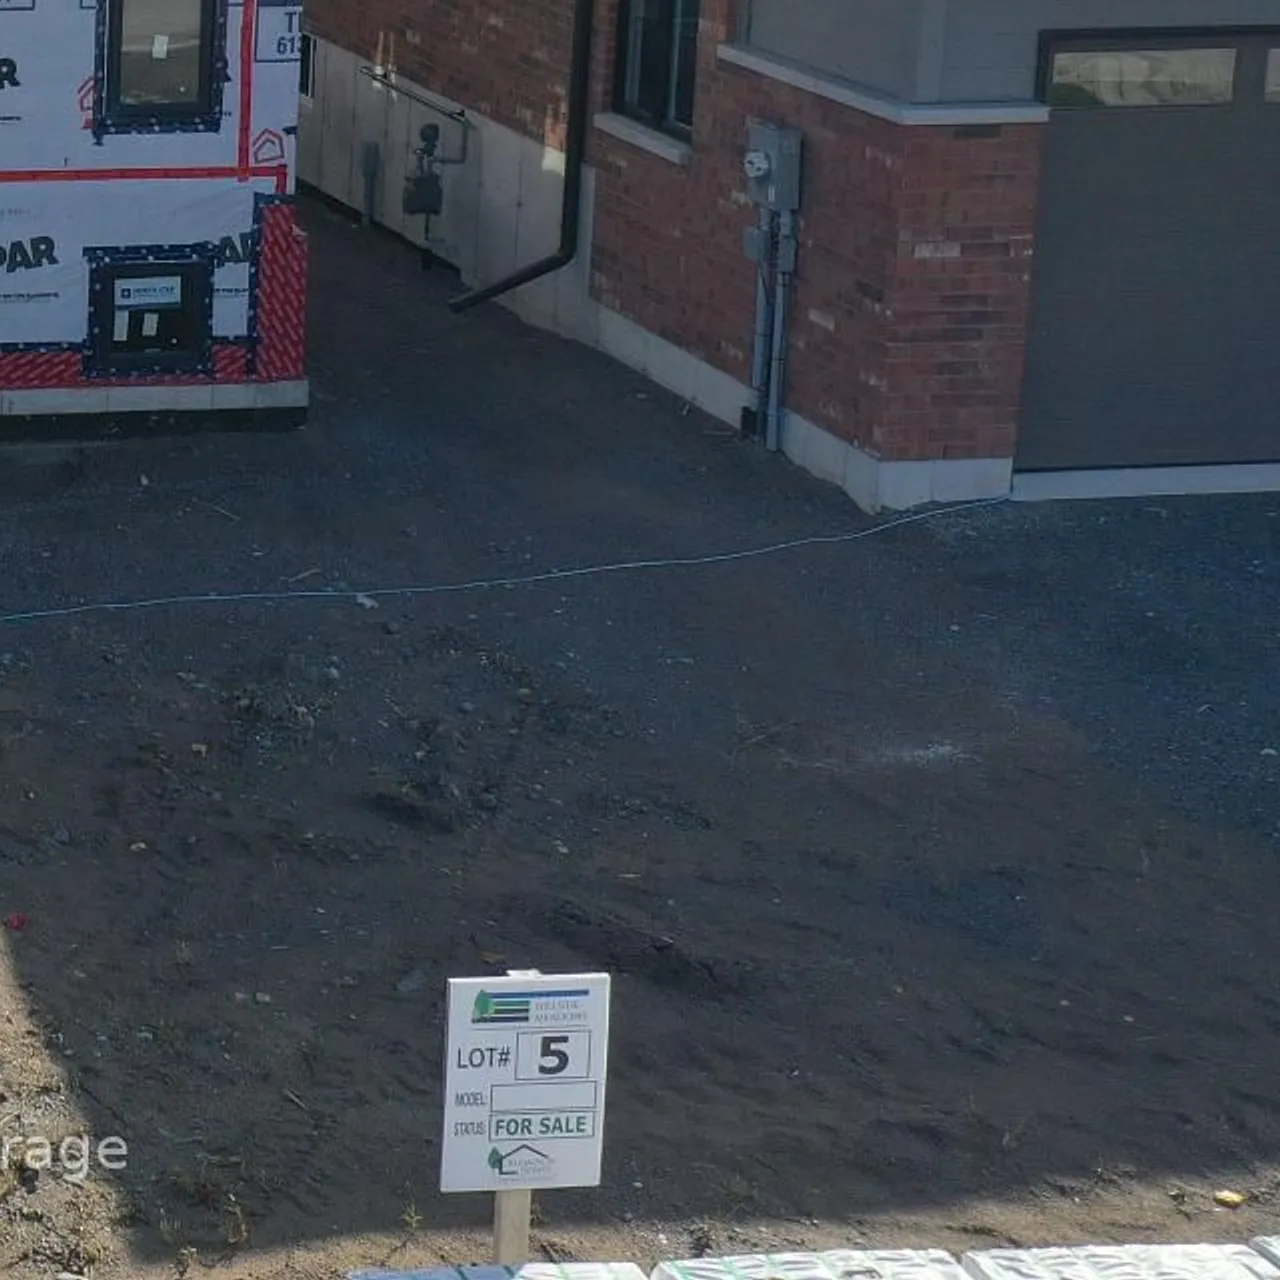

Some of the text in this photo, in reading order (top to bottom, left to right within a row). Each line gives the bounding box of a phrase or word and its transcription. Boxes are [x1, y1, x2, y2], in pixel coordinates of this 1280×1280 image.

[457, 1045, 511, 1070] LOT#
[539, 1035, 570, 1076] 5
[495, 1115, 587, 1137] FOR SALE
